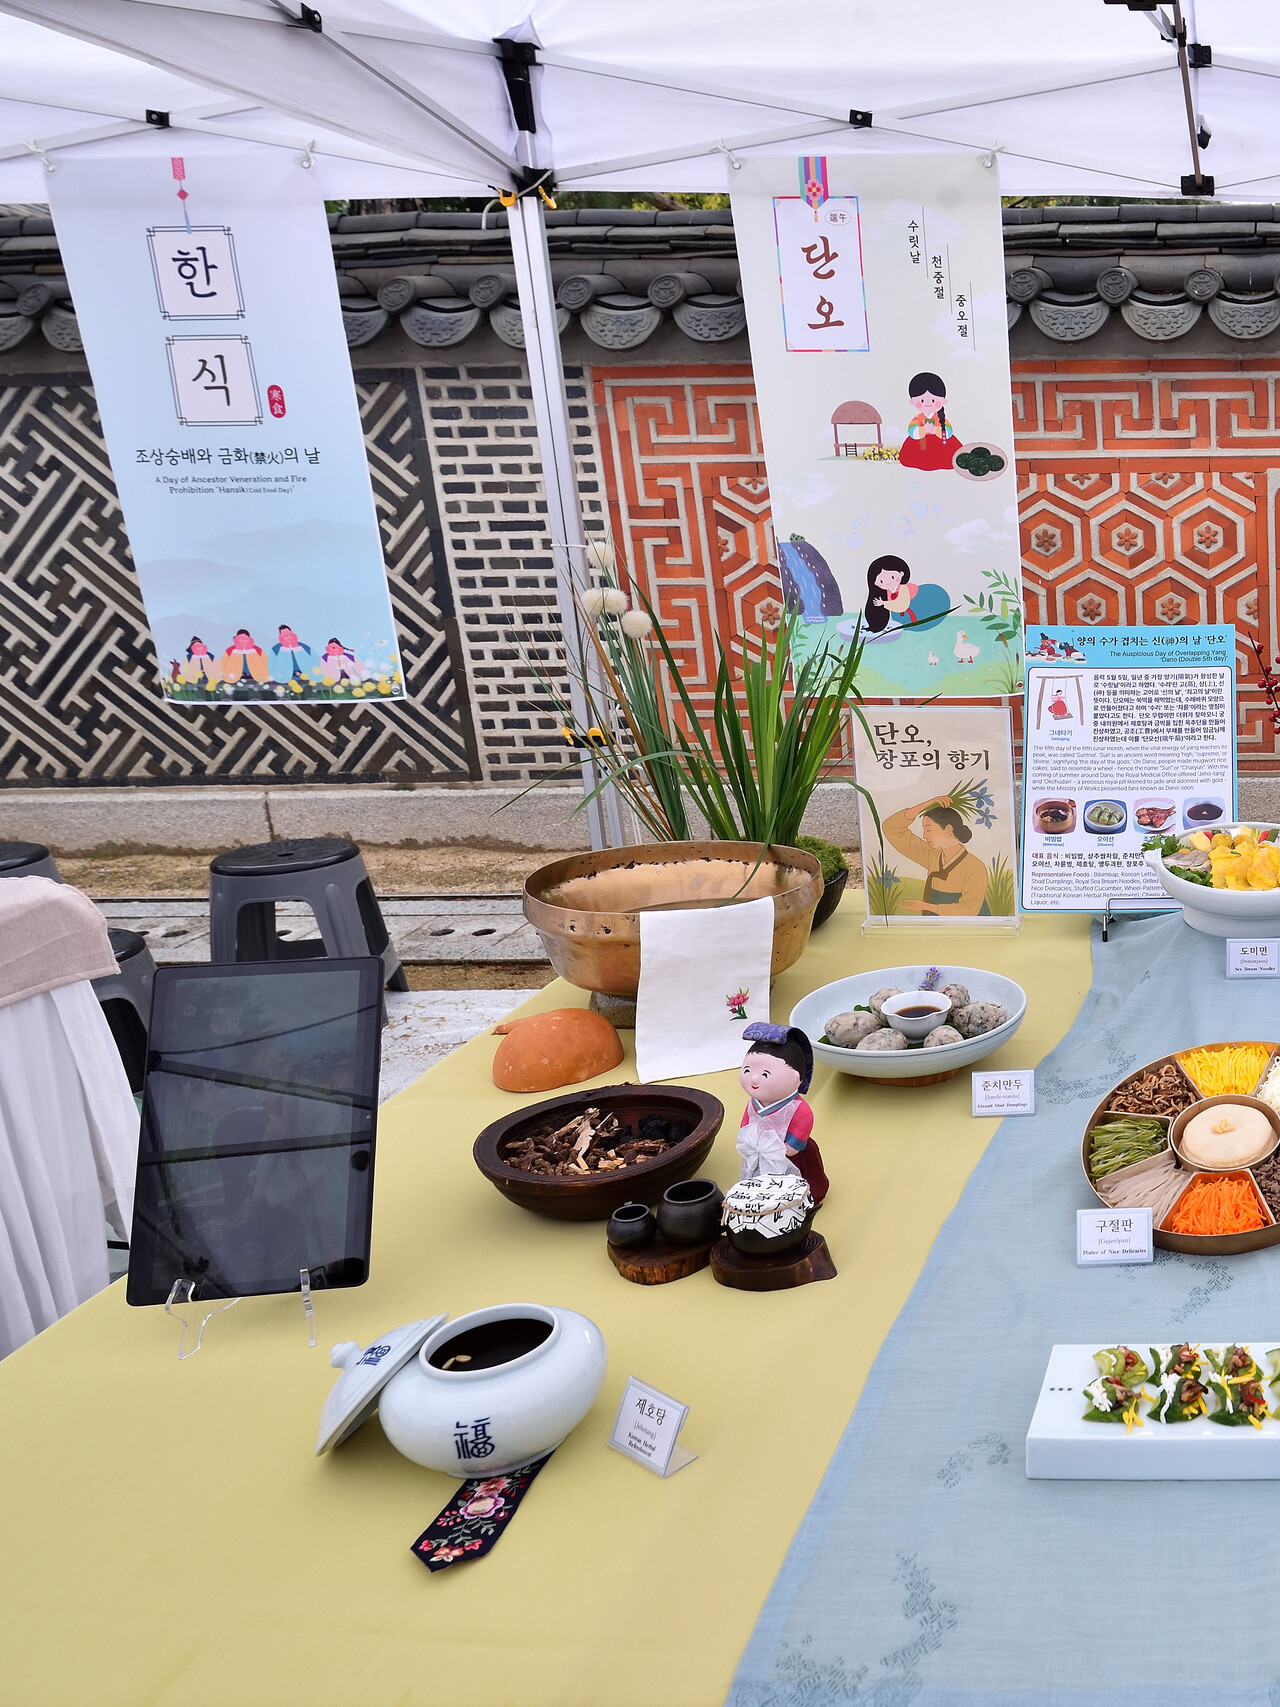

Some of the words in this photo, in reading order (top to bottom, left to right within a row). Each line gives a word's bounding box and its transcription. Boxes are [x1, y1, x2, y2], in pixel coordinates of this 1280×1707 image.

[908, 220, 920, 264] 수릿날
[801, 236, 844, 330] 단오
[932, 255, 945, 299] 천중절
[956, 294, 968, 337] 중오절
[136, 448, 212, 466] 조상숭배와
[218, 447, 299, 465] 금화(禁火)의
[304, 447, 320, 465] 날
[163, 476, 178, 485] Day
[169, 486, 214, 494] Prohibition
[1078, 637, 1095, 646] 양의
[1099, 637, 1118, 646] 수가
[1122, 636, 1148, 646] 겹치는
[1193, 636, 1201, 645] 날
[874, 722, 932, 747] 단오,
[878, 749, 940, 770] 창포의
[948, 749, 990, 770] 향기
[982, 1079, 1023, 1091] 준치만두
[1096, 1219, 1133, 1233] 구절판
[635, 1398, 666, 1425] 제호탕
[454, 1417, 495, 1460] 福
